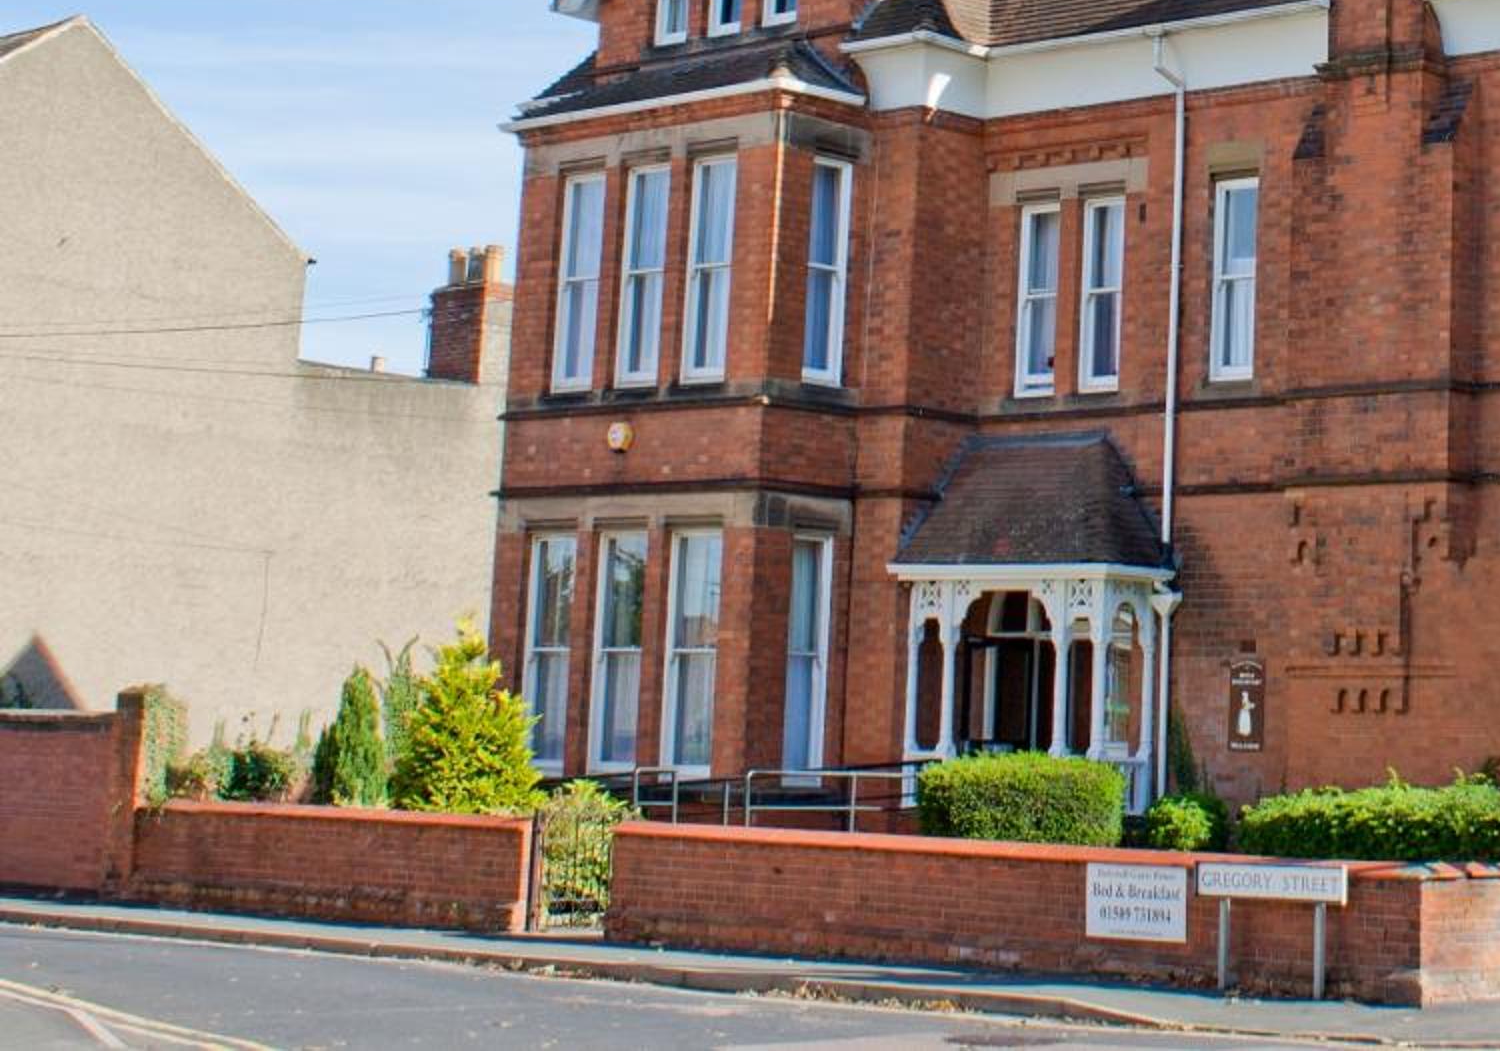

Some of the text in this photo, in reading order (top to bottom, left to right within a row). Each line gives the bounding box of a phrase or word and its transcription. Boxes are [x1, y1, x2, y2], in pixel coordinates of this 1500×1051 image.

[1093, 882, 1181, 901] Bed & Breakfast
[1201, 870, 1340, 894] GREGORY STREET
[1099, 904, 1131, 921] 01509
